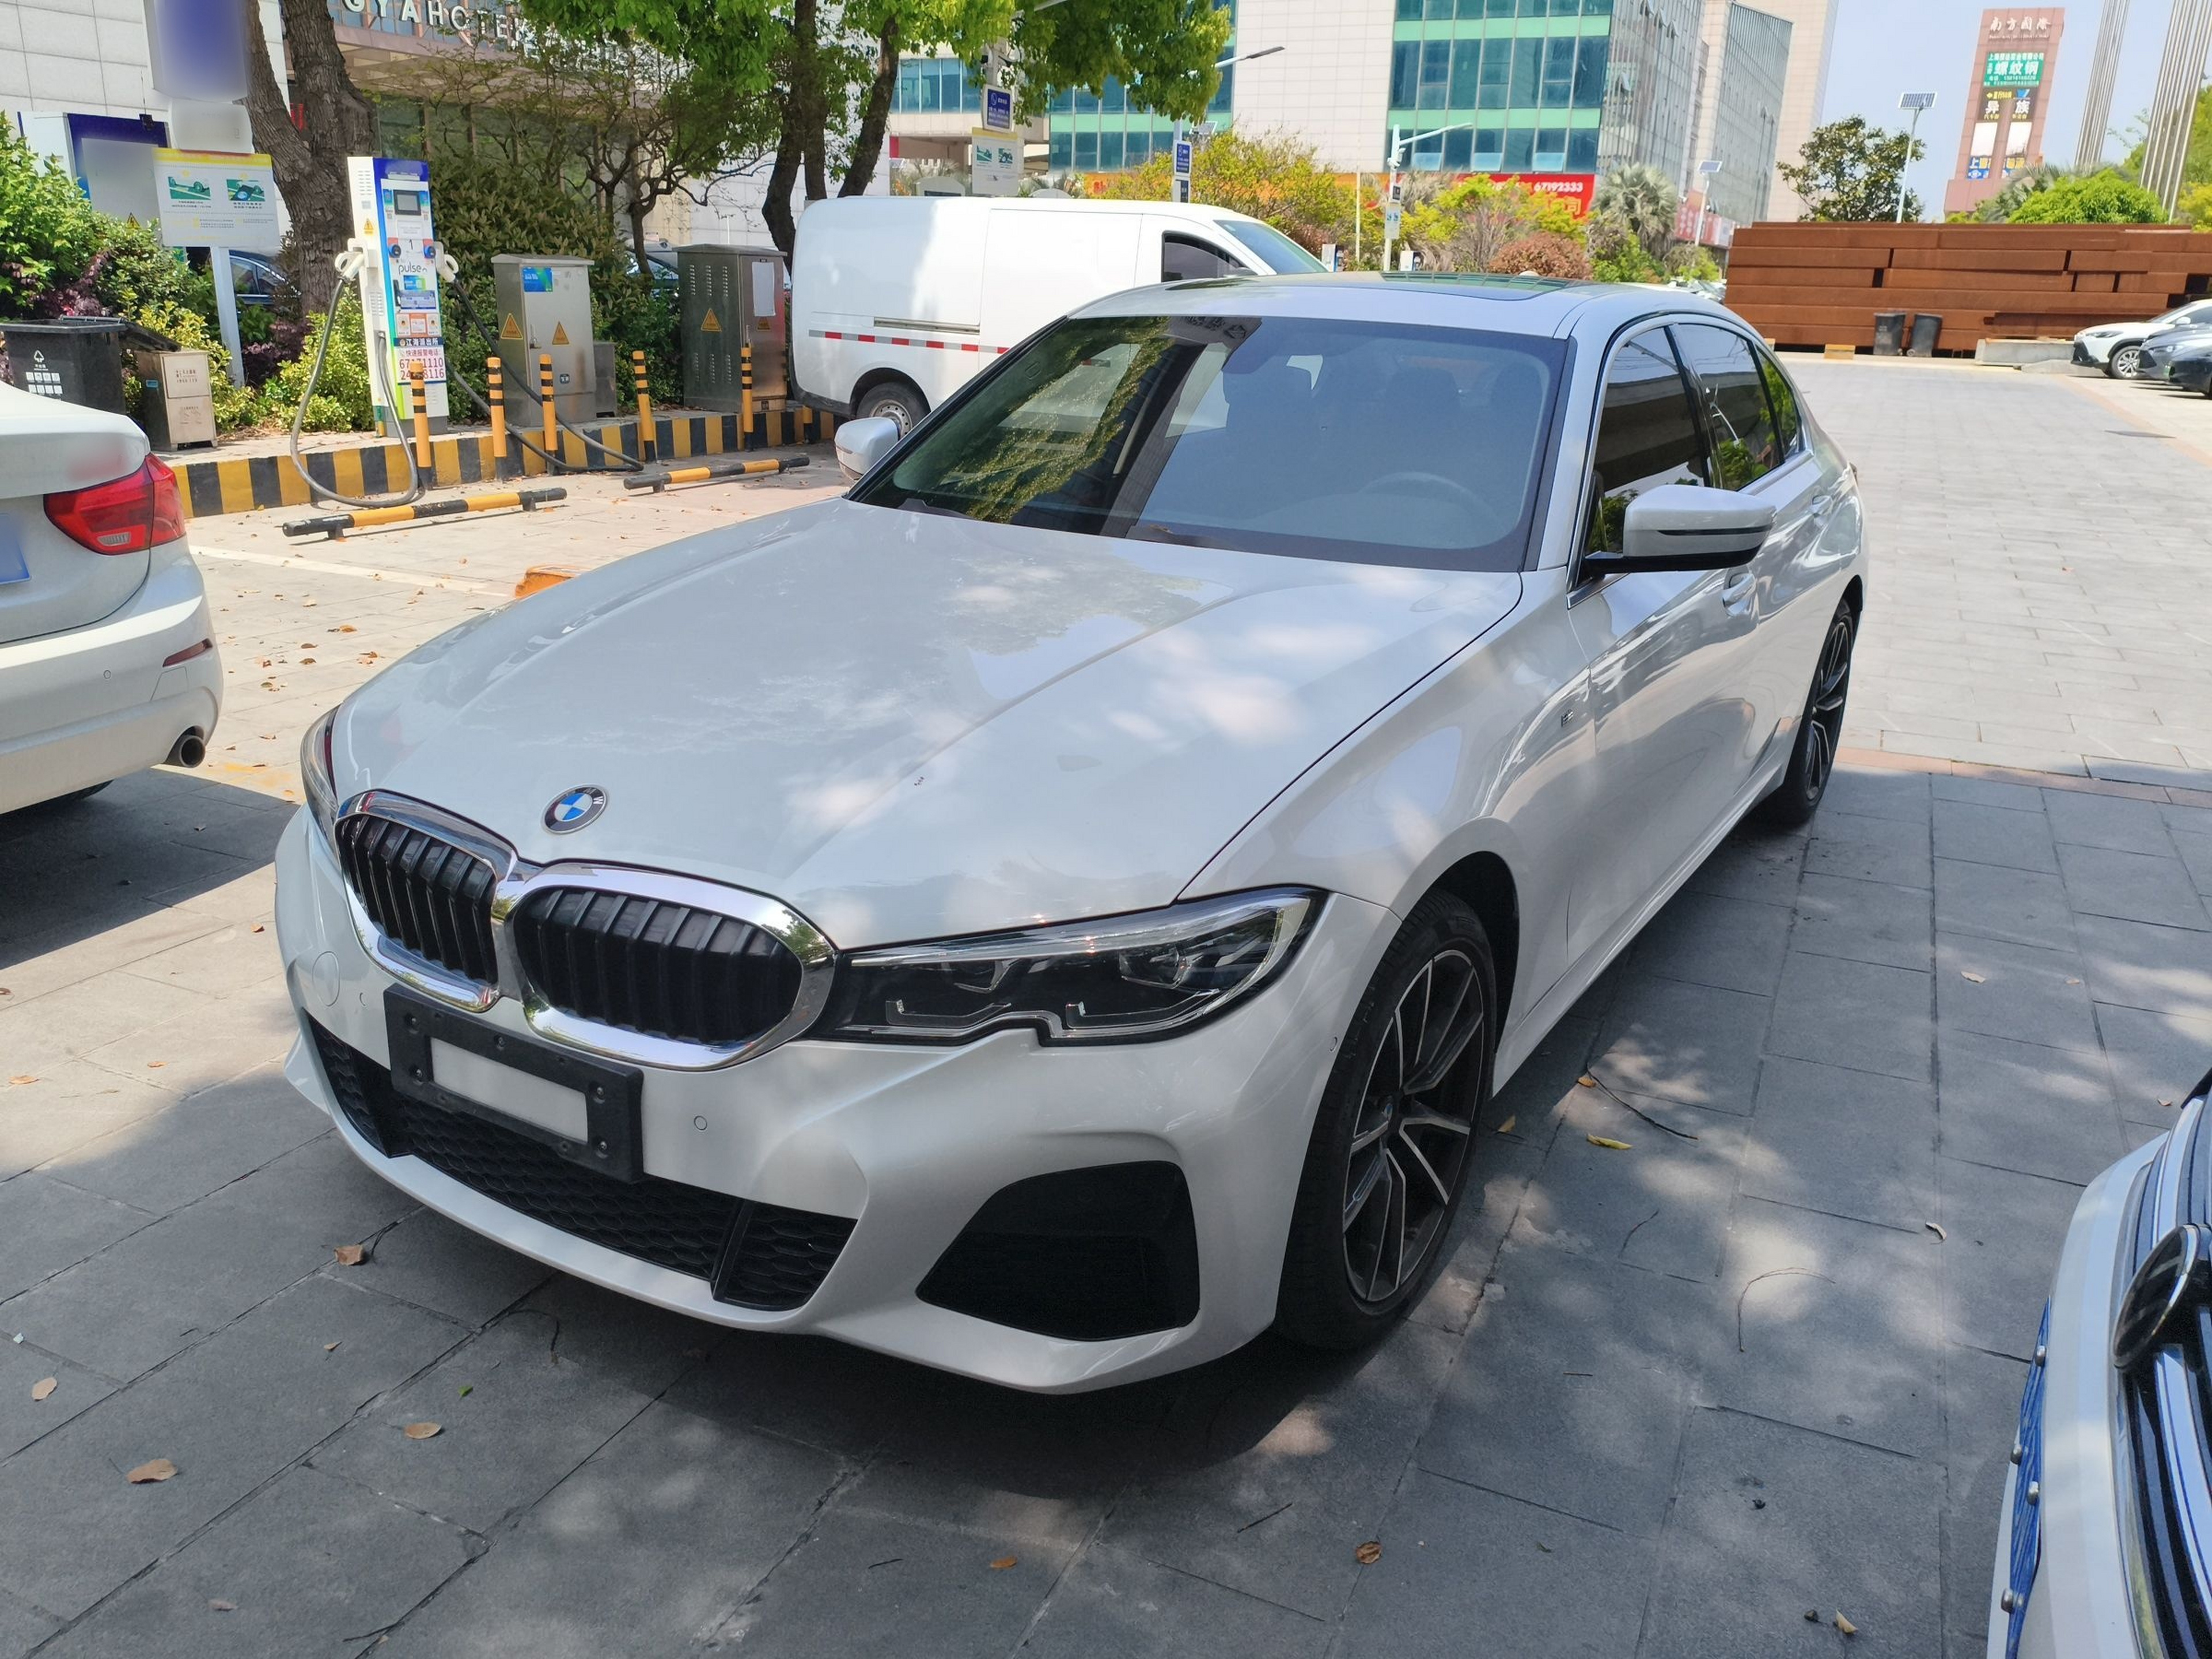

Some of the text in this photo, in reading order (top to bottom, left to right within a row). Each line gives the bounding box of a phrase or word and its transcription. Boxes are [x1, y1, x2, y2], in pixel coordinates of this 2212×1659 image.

[1533, 182, 1584, 192] 67192333
[398, 261, 422, 275] pulse
[406, 338, 438, 346] 江海派出所
[399, 358, 444, 369] 671110
[400, 369, 445, 380] 248116
